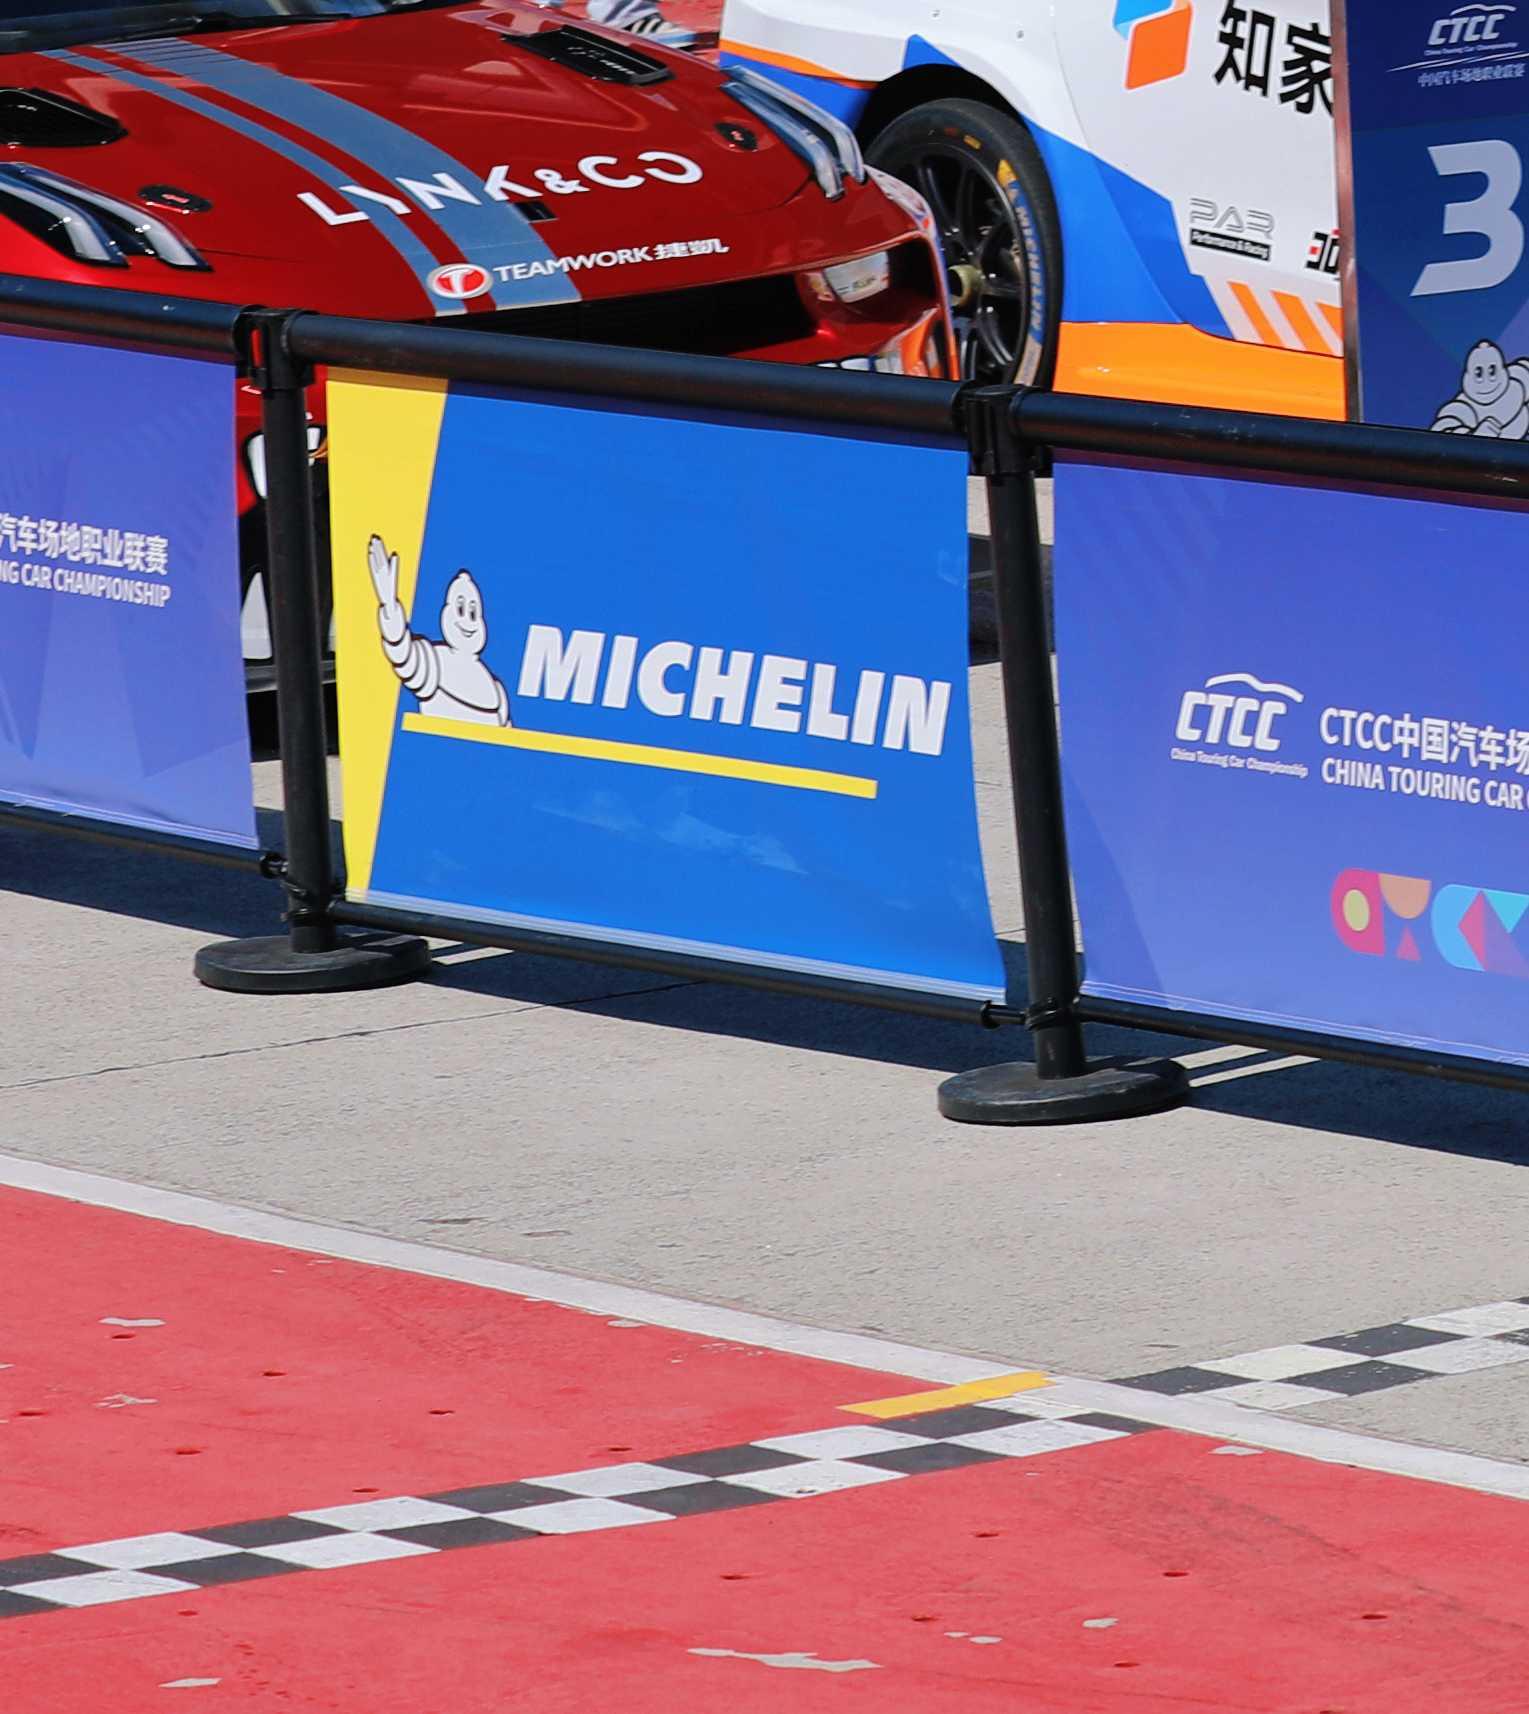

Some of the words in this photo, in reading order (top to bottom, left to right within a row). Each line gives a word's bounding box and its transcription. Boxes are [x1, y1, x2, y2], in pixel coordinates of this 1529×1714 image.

[1428, 13, 1506, 46] CTCC
[1189, 197, 1276, 240] PAR
[493, 246, 654, 282] TEAMWORK
[20, 562, 53, 591] CAR
[52, 567, 172, 609] CHAMPIONSHIP
[516, 624, 952, 757] MICHELIN
[1176, 689, 1289, 752] CTCC
[1170, 746, 1196, 763] China
[1195, 750, 1229, 770] Touring
[1228, 754, 1246, 769] Car
[1245, 756, 1309, 780] Championship
[1320, 756, 1385, 791] CHINA
[1386, 764, 1481, 806] TOURING
[1482, 778, 1525, 812] CAR
